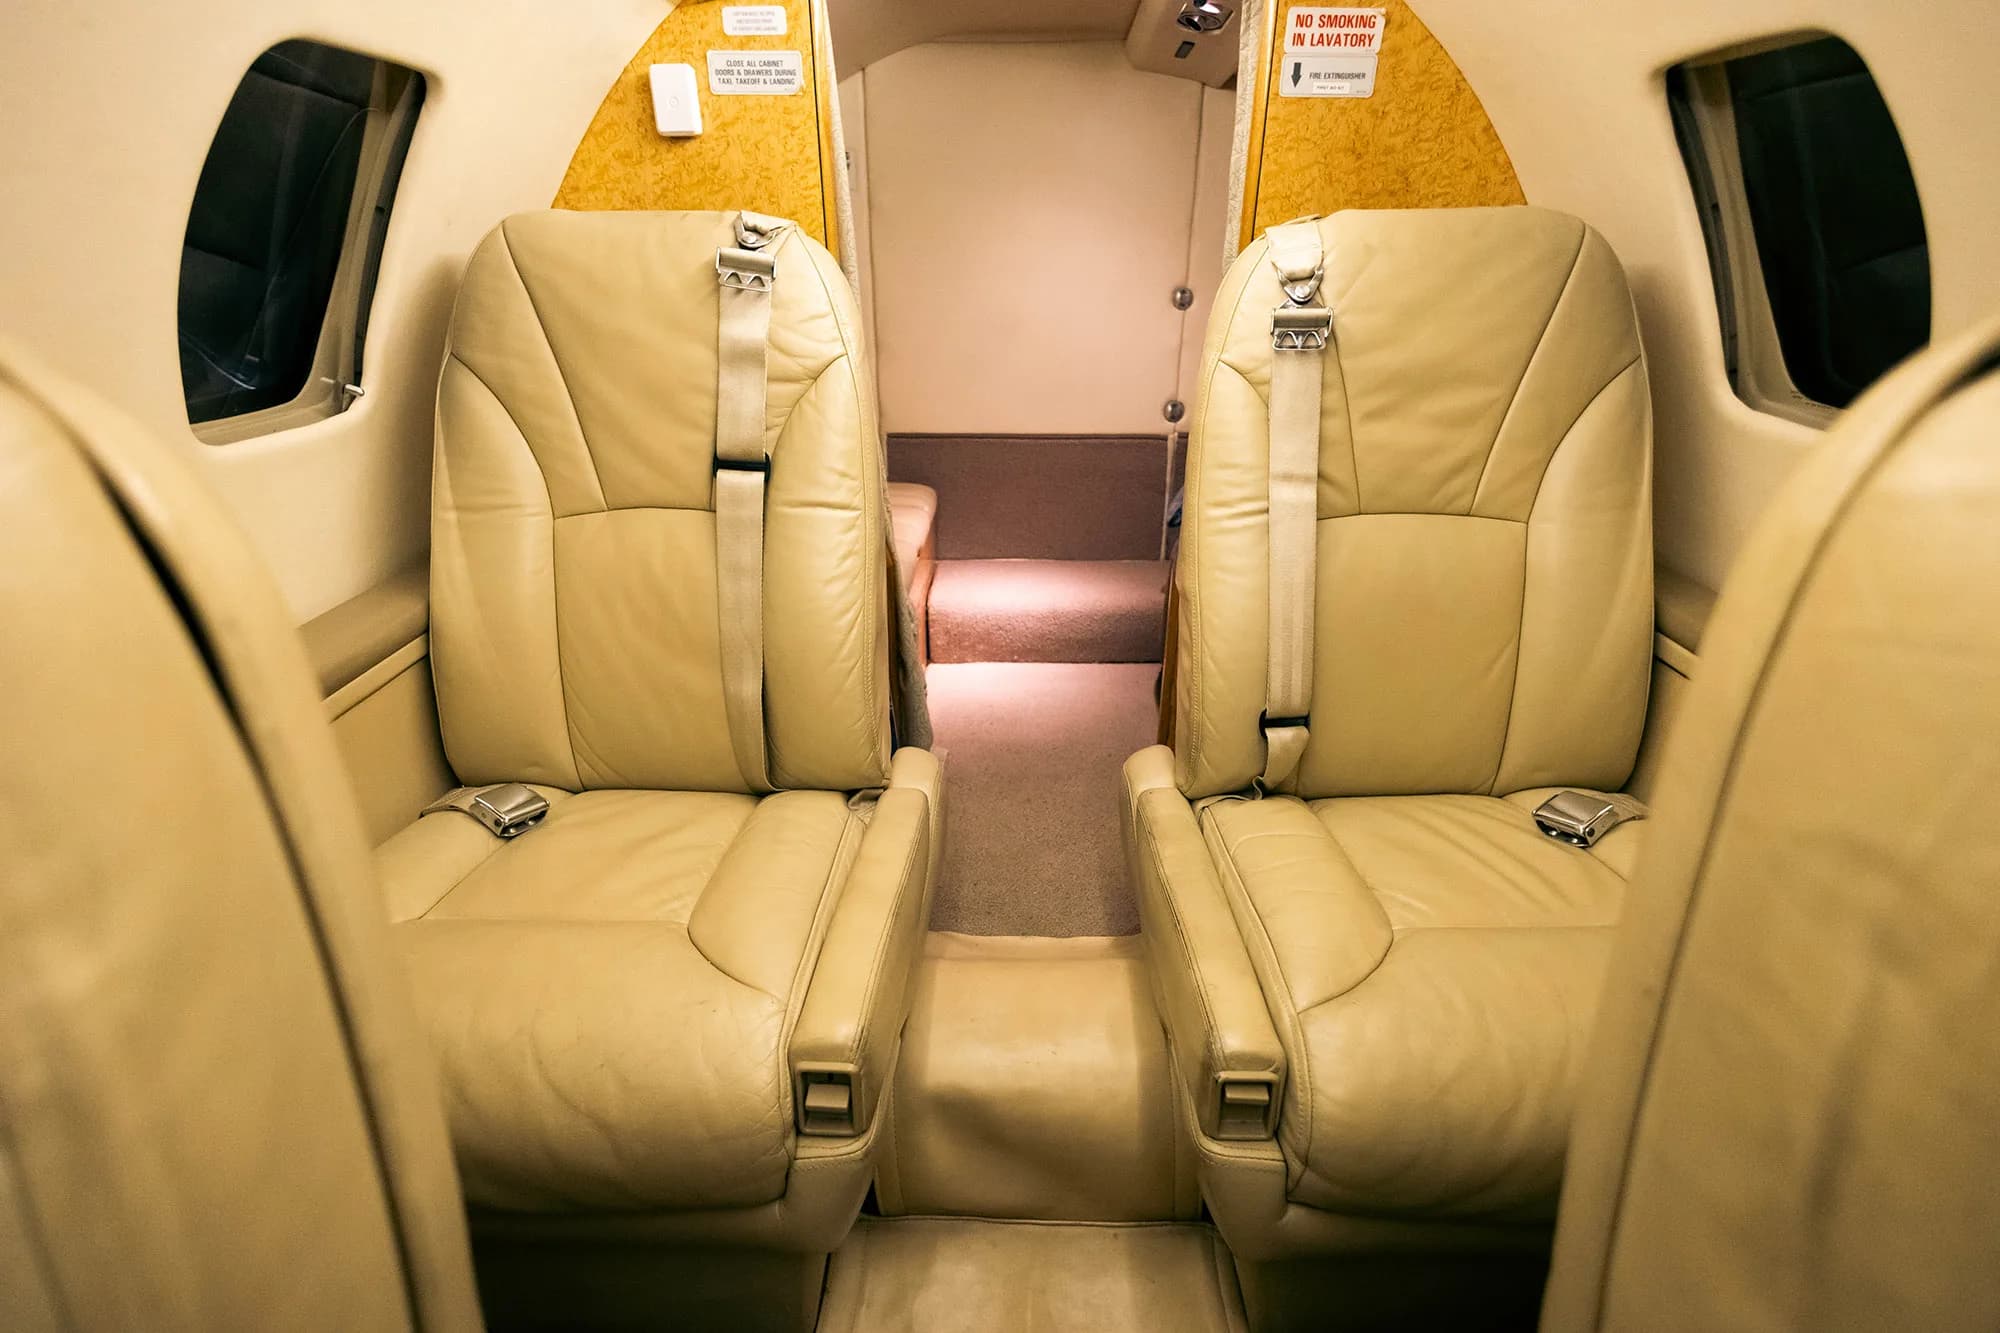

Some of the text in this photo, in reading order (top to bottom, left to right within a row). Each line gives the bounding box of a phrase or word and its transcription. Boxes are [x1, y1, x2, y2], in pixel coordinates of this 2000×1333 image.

[1296, 14, 1376, 28] NO SMOKING
[1292, 33, 1375, 47] IN LAVATORY
[1324, 72, 1366, 80] EXTINGUISHER
